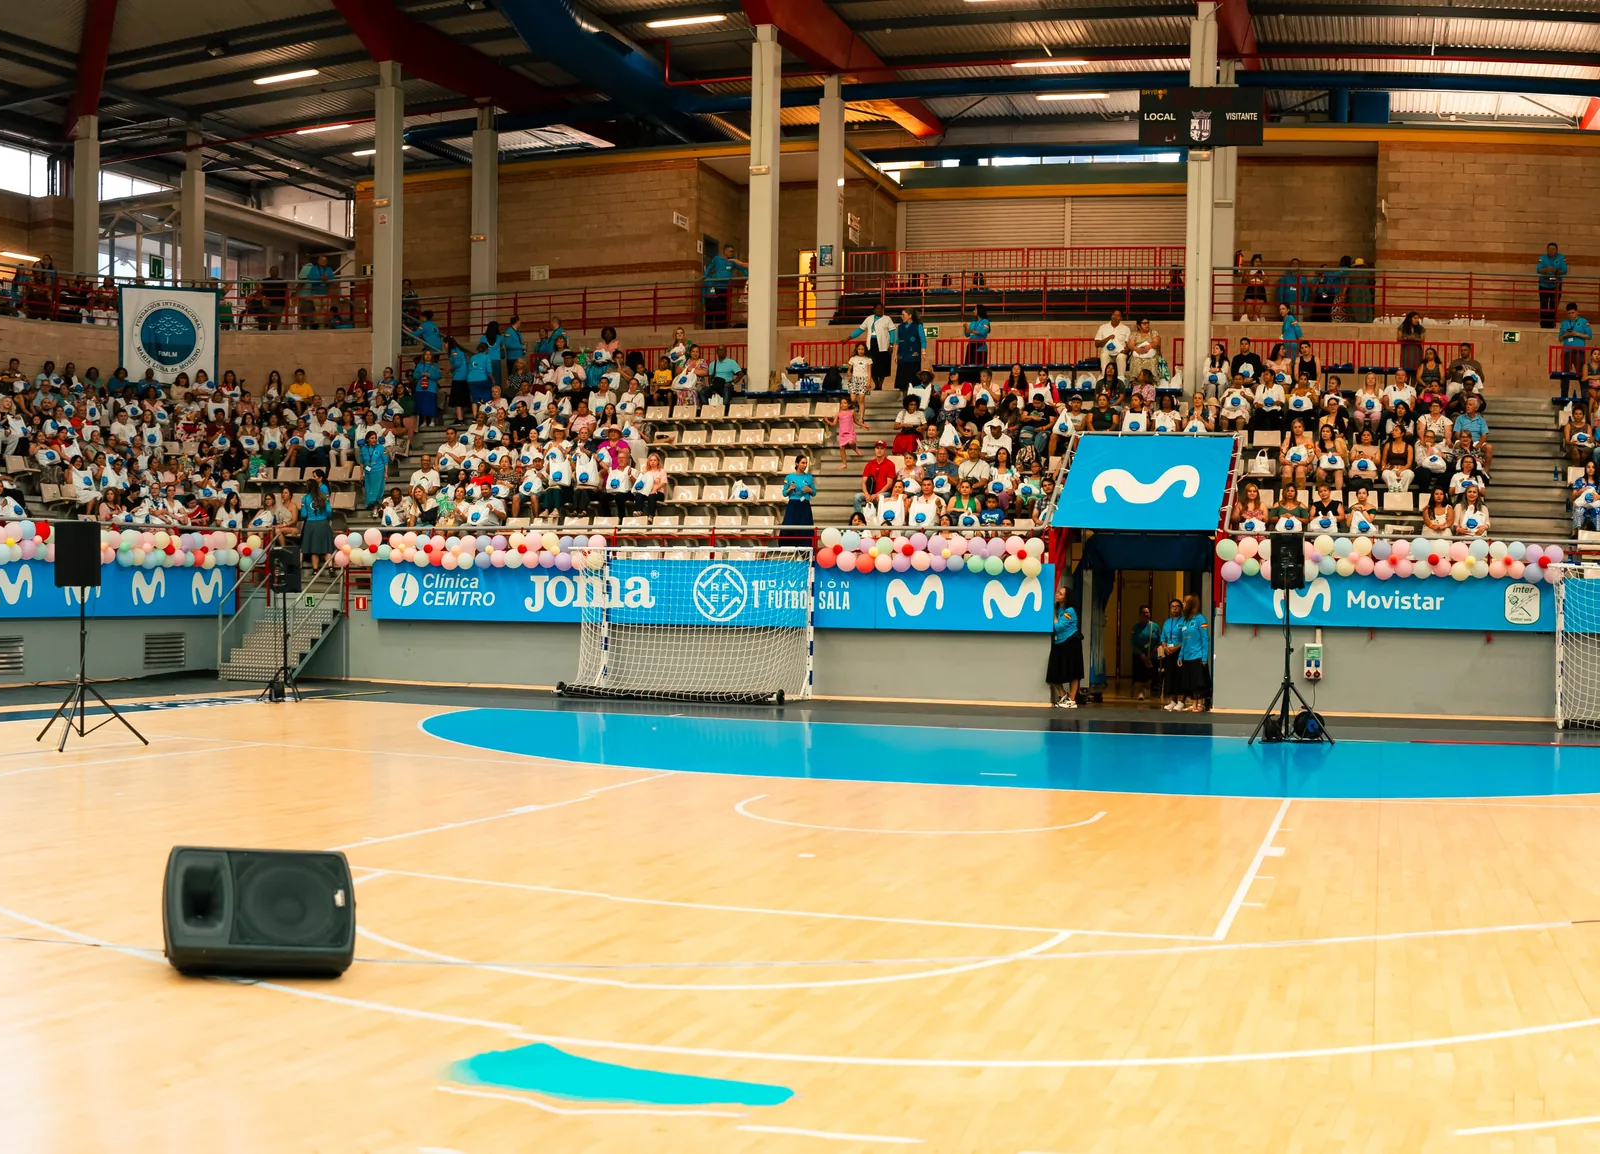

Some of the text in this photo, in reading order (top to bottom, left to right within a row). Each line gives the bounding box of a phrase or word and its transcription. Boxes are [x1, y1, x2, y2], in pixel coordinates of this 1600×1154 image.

[1144, 113, 1176, 121] LOCAL
[1226, 112, 1258, 120] VISITANTE
[423, 573, 479, 589] Clínica
[768, 579, 850, 589] DIVIIÓN
[423, 591, 496, 607] CEMTRO
[768, 588, 850, 610] FÚTBO SALA
[1347, 590, 1445, 610] Movistar
